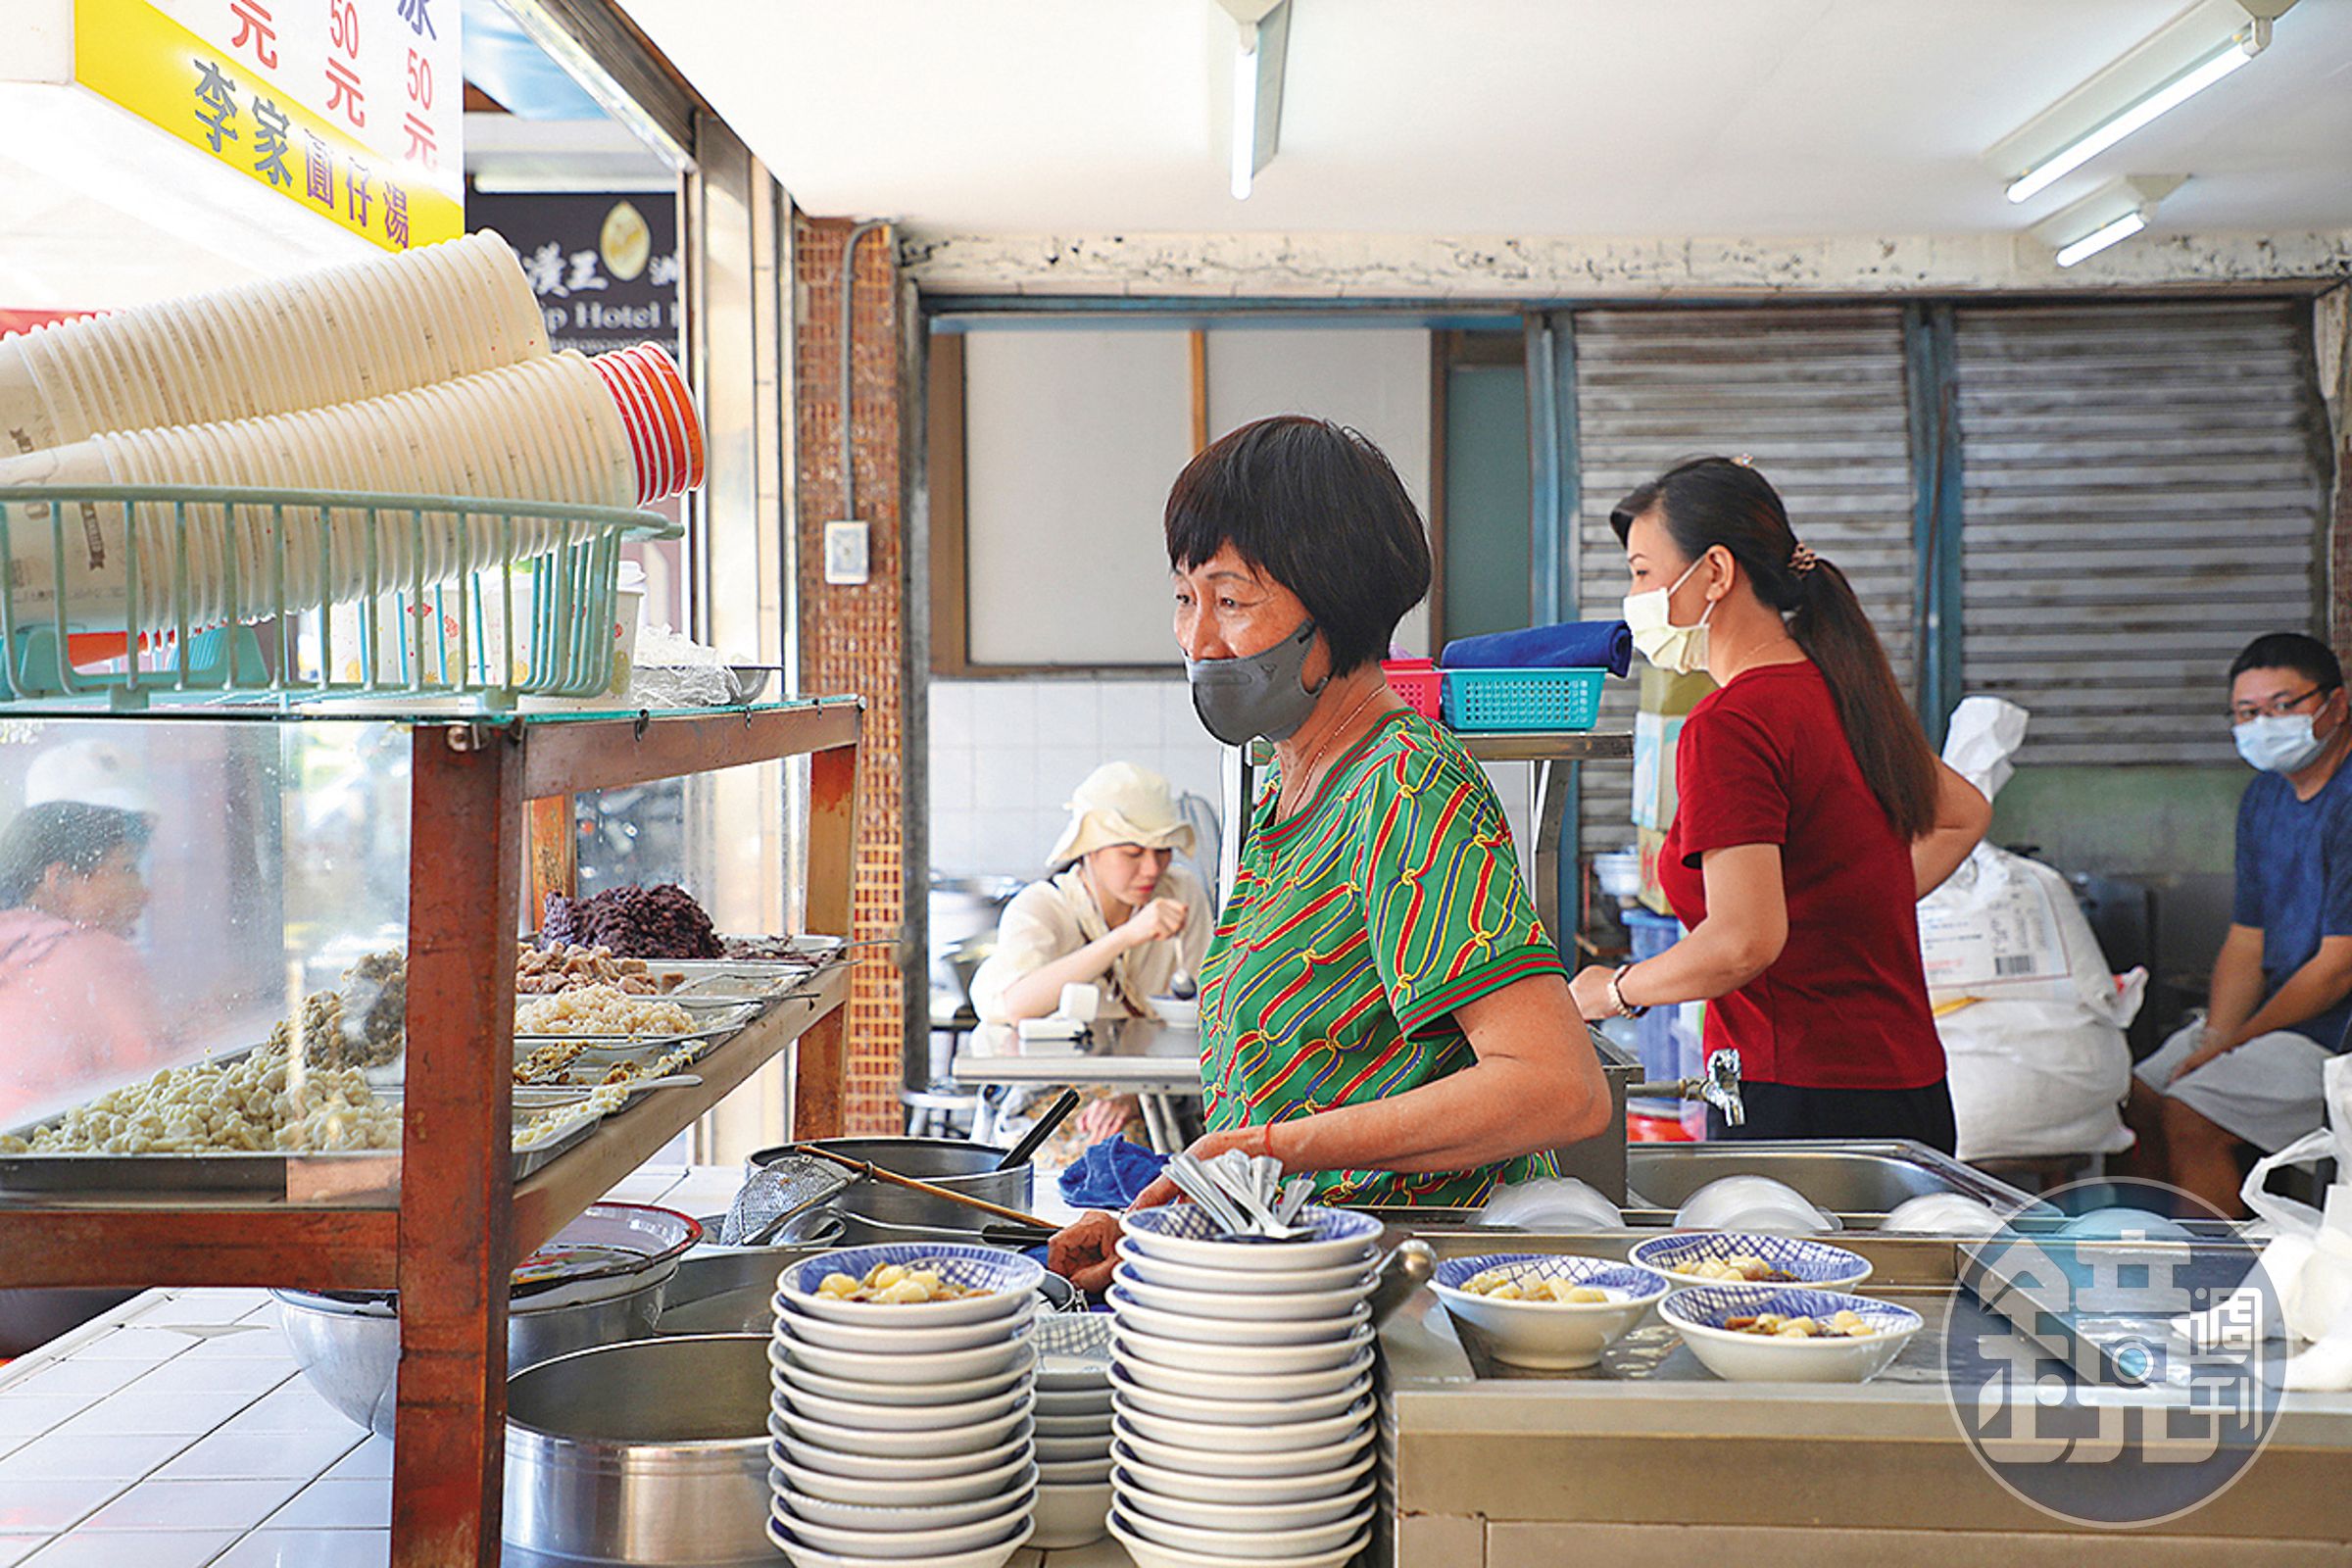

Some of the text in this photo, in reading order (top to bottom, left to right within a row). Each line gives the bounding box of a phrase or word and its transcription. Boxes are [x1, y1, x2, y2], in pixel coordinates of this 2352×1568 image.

[193, 59, 410, 249] 李家圓仔湯
[574, 300, 662, 329] Hotel
